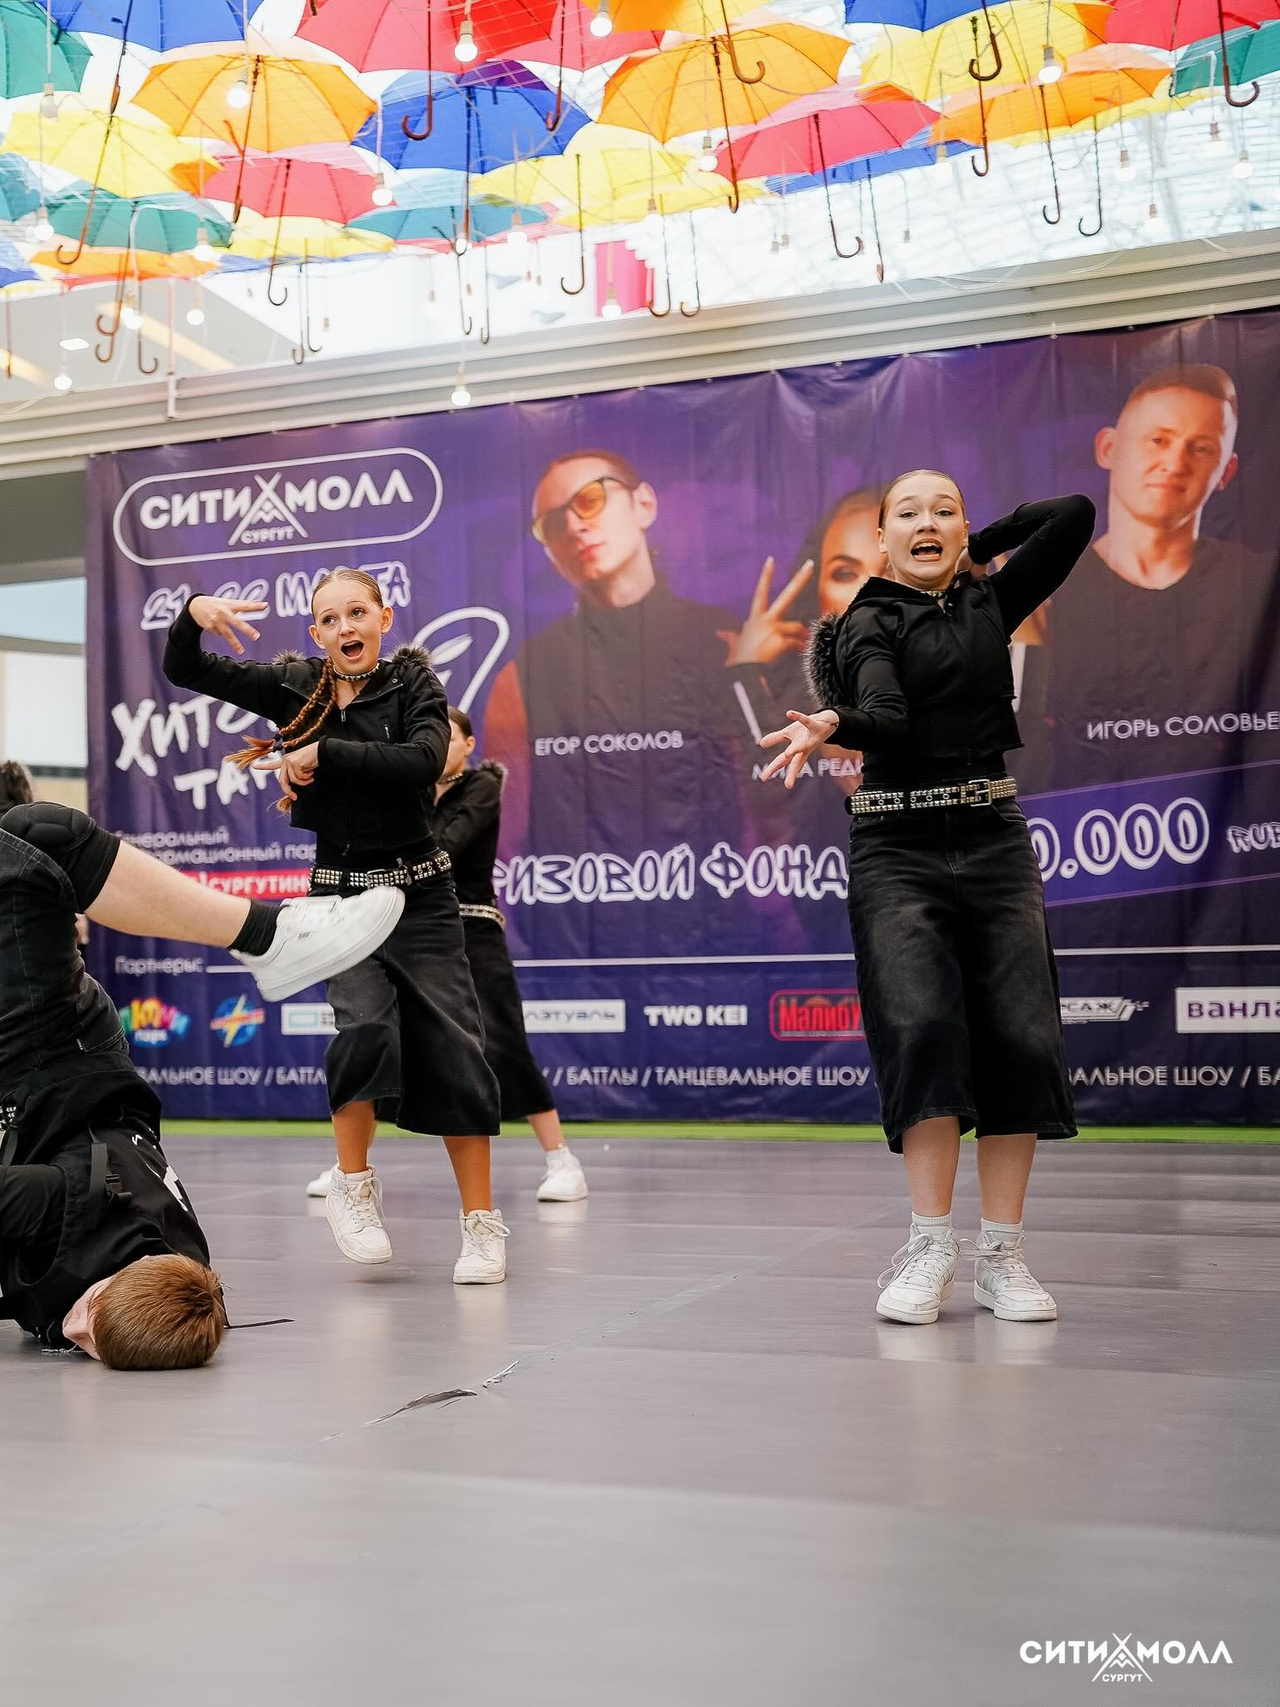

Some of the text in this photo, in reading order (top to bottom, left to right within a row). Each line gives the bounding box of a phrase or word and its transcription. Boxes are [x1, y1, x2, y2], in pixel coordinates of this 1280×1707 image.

[139, 468, 414, 530] СИТИ МОЛЛ
[240, 525, 295, 544] СУРГУТ
[1087, 719, 1160, 741] ИГОРЬ
[534, 729, 685, 756] ЕГОР СОКОЛОВ
[644, 1005, 749, 1027] TWO KEI
[217, 1065, 263, 1086] ШОУ
[656, 1065, 813, 1088] ТАНЦЕВАЛЬНОЕ
[816, 1065, 871, 1087] ШОУ
[1173, 1065, 1234, 1087] ШОУ
